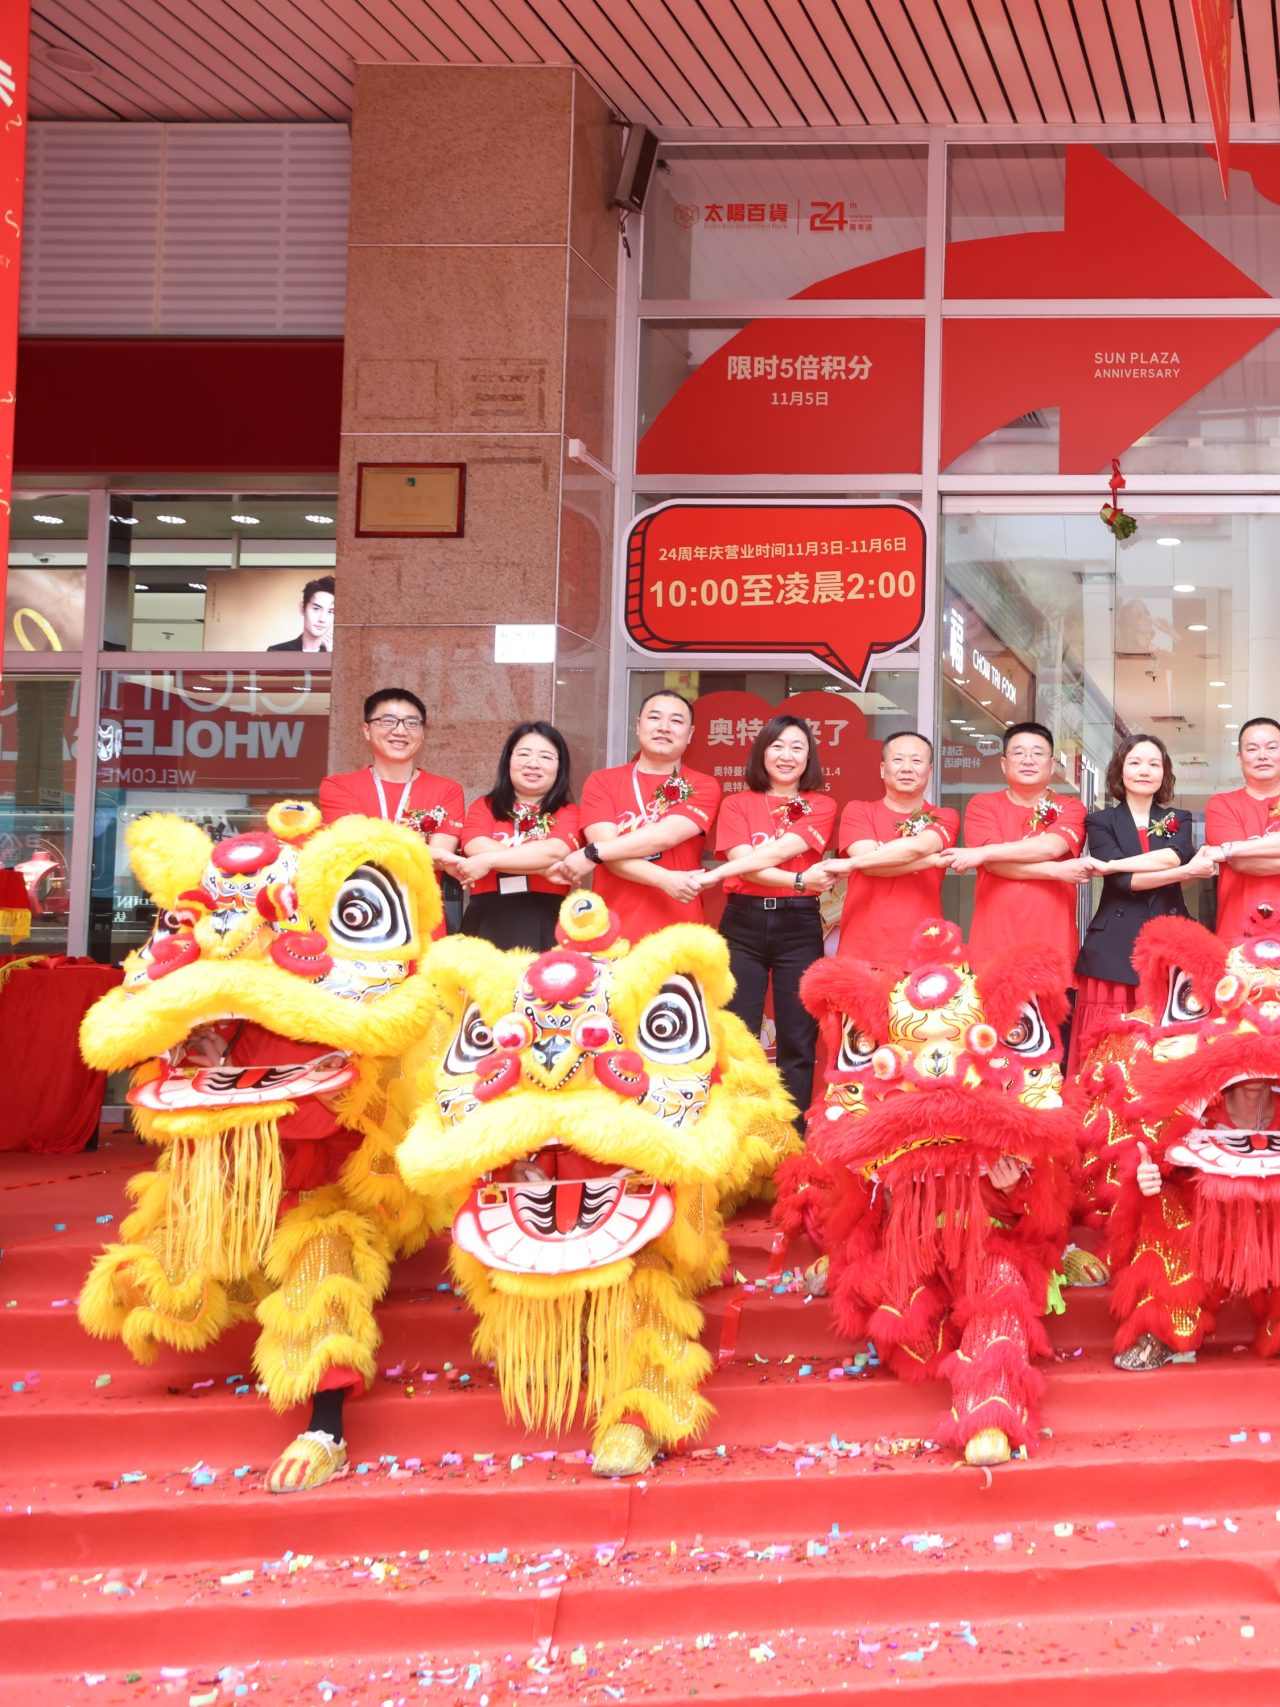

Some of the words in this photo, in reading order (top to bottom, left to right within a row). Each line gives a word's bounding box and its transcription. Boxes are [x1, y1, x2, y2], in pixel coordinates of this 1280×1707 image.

[704, 203, 788, 222] 太陽百貨
[810, 202, 848, 231] 24
[727, 355, 873, 381] 限时5倍积分
[1094, 352, 1126, 364] SUN
[1130, 352, 1180, 364] PLAZA
[1094, 368, 1180, 378] ANNIVERSARY
[771, 391, 829, 406] 11月5日
[658, 536, 907, 562] 24周年庆营业时间11月3日-11月6日
[649, 569, 916, 608] 10:00至凌晨2:00
[973, 648, 991, 681] CHOW
[991, 664, 1001, 691] TAI
[1001, 676, 1017, 705] FOOK
